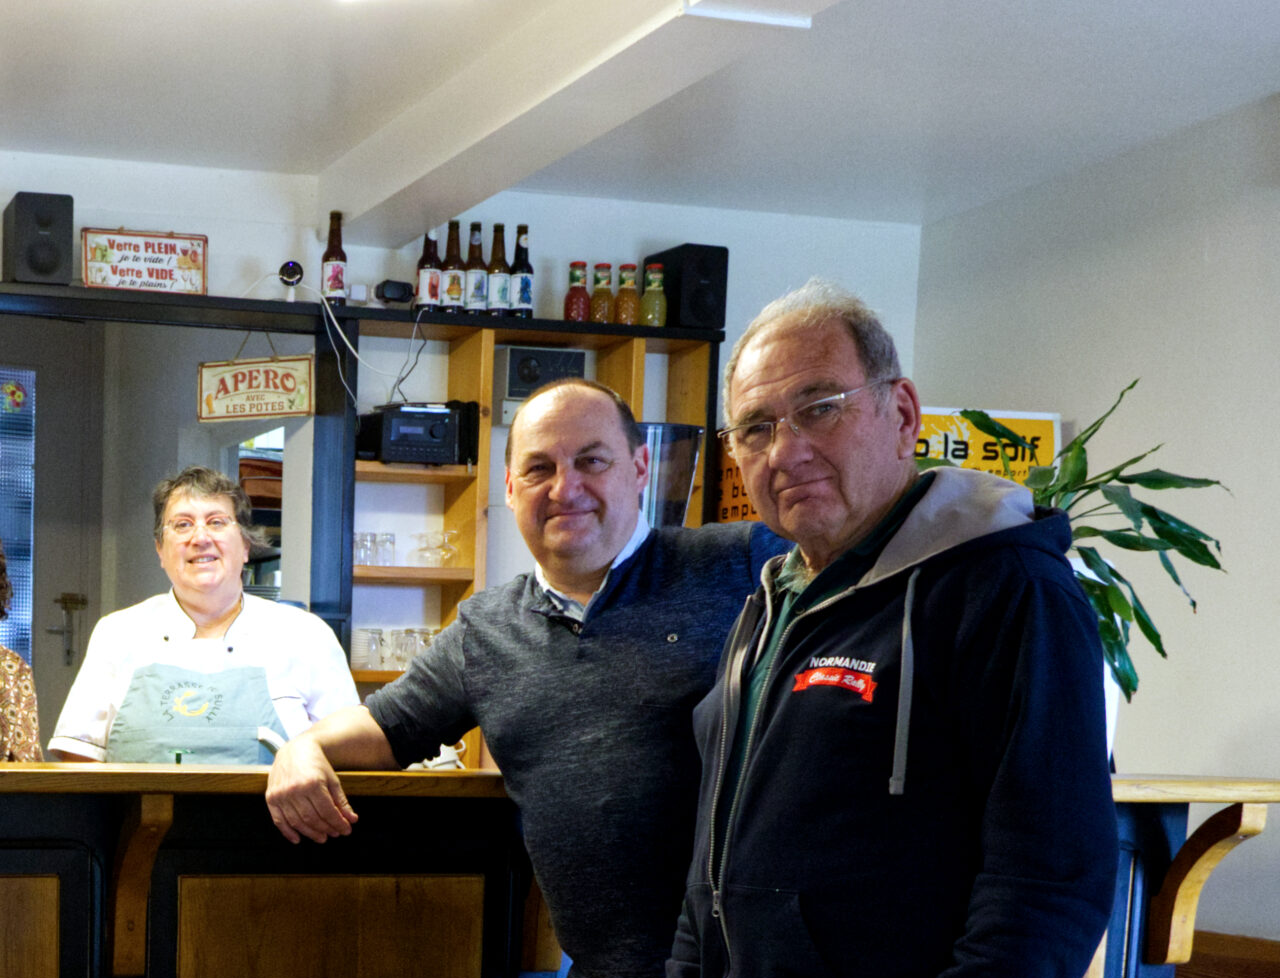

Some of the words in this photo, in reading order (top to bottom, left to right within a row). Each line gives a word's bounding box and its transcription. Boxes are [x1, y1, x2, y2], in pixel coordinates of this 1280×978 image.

[107, 239, 140, 253] Verre
[143, 255, 164, 263] vide
[110, 264, 143, 278] Verre
[214, 368, 297, 400] APERO
[226, 404, 246, 414] LES
[249, 401, 285, 412] POTES
[943, 432, 969, 459] la
[809, 656, 876, 673] NORMANDIE
